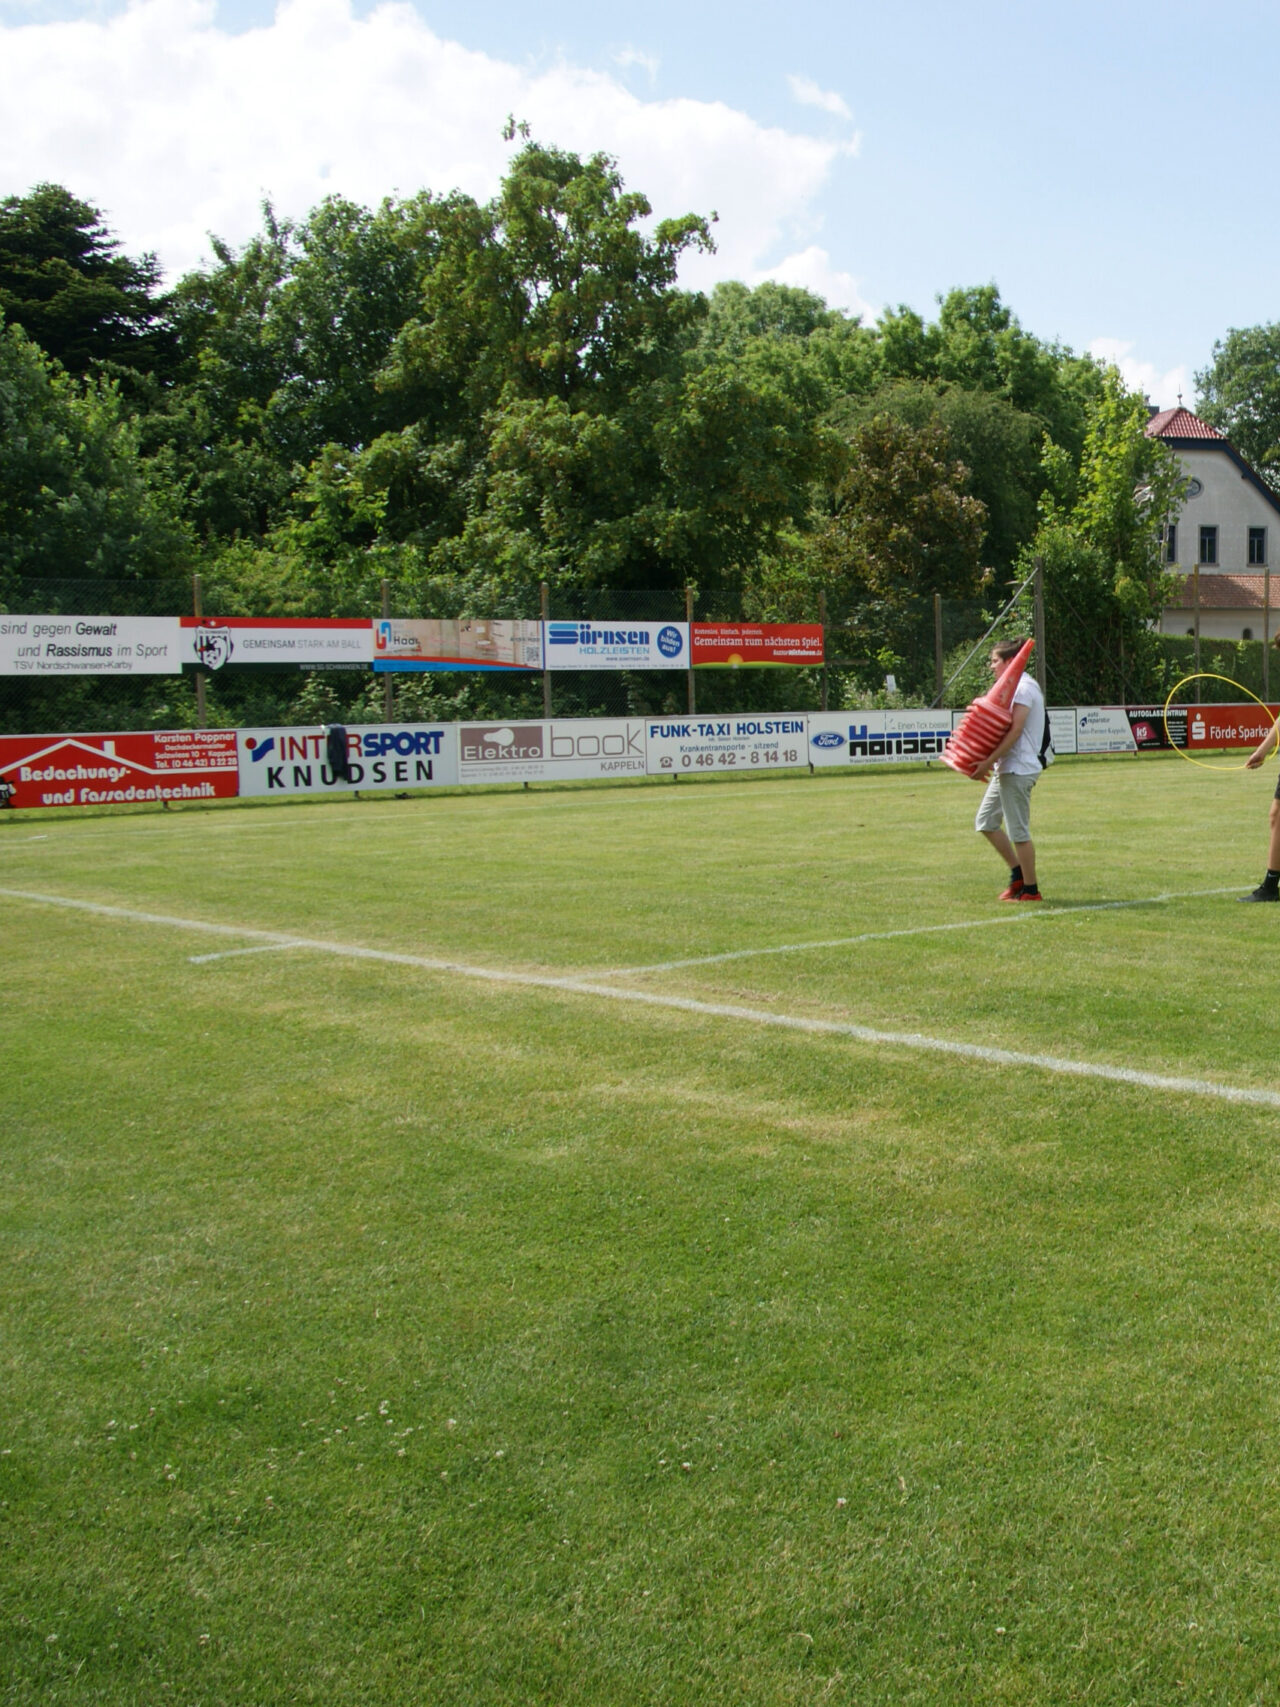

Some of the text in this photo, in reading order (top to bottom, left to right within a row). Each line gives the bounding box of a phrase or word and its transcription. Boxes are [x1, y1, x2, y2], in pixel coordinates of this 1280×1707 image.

[1, 621, 117, 638] sind gegen Gewalt
[242, 639, 362, 649] GEMEINSAM STARK AM BALL
[694, 636, 823, 649] Gemeinsam zum nächsten Spiel.
[17, 643, 168, 659] und Rassismus im Sport
[578, 646, 650, 655] HOLZLEISTEN
[13, 660, 34, 670] TSV
[1129, 710, 1188, 718] AUTOGLASZNTRUM
[650, 721, 804, 738] FUNK-TAXI HOLSTEIN
[1210, 726, 1236, 739] Förde
[154, 733, 192, 743] Karsten
[551, 723, 644, 757] book
[818, 734, 840, 746] Ford
[280, 731, 445, 761] INTRSPORT
[680, 743, 746, 753] Krankentransporte
[754, 742, 779, 750] sitzend
[464, 746, 541, 760] Elektro
[681, 755, 692, 768] 0
[695, 754, 714, 767] 46
[718, 753, 737, 766] 42
[750, 752, 760, 764] 8
[763, 751, 779, 763] 14
[784, 750, 798, 762] 18
[156, 760, 170, 768] Tel.
[601, 761, 645, 772] KAPPELN
[20, 765, 131, 782] Bedachungs-
[267, 760, 434, 788] KNUDSEN
[42, 782, 215, 805] und Fassadentechnik
